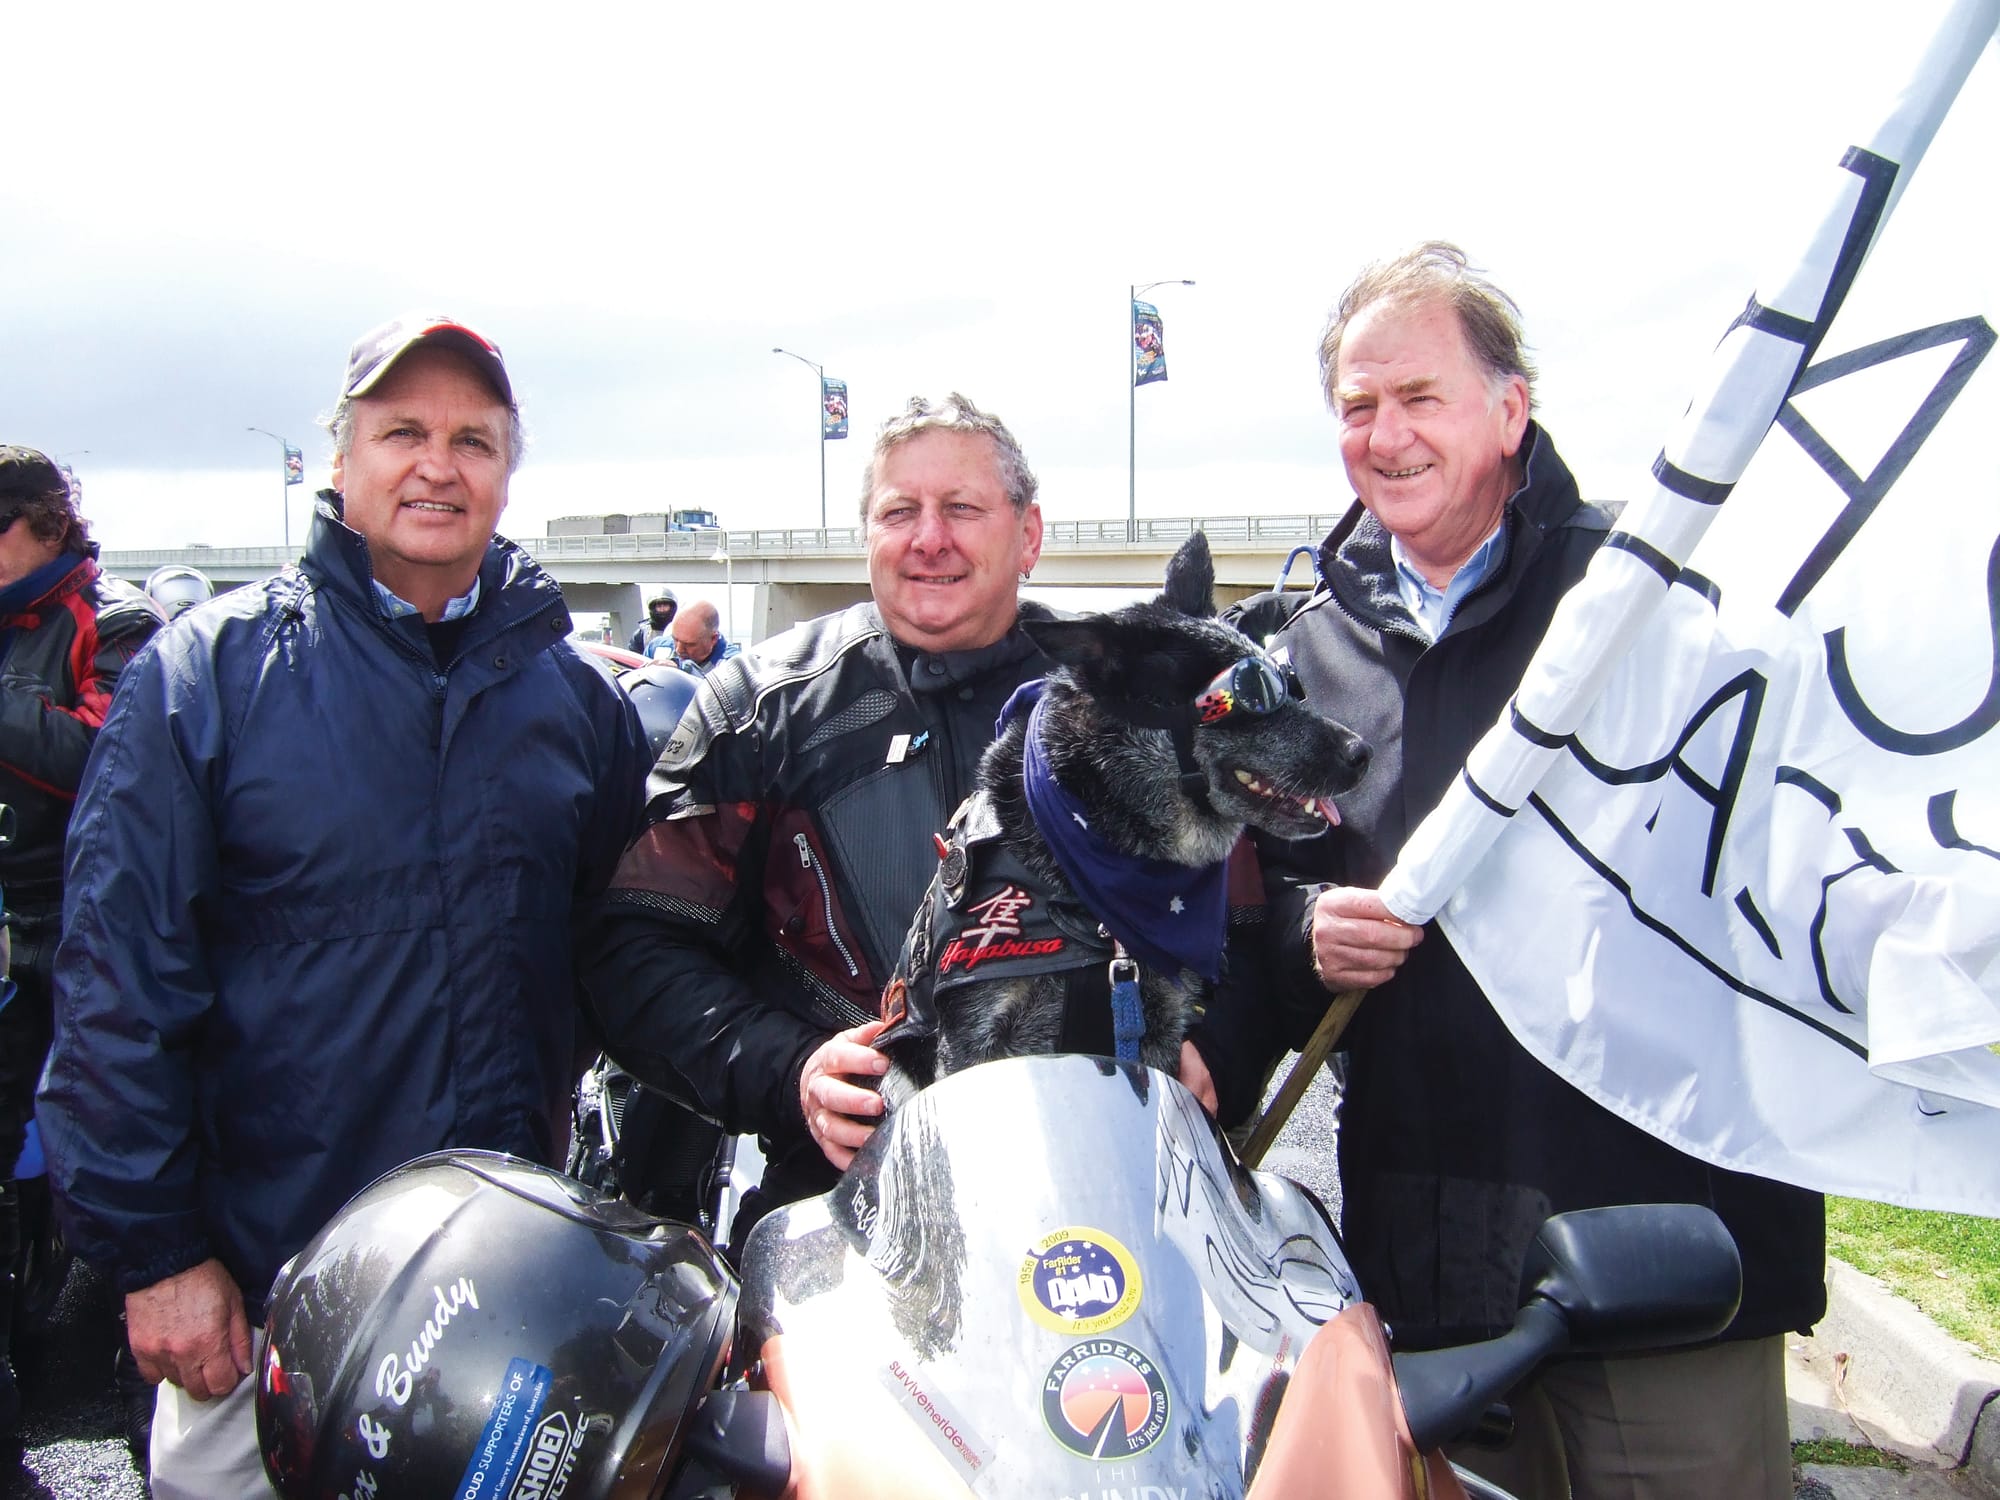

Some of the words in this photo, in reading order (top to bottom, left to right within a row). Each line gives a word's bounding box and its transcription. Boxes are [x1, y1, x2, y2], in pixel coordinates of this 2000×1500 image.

[940, 938, 1063, 973] Hayabusa
[1042, 1231, 1069, 1247] 2009
[1043, 1255, 1082, 1269] FarRider
[359, 1413, 391, 1459] &
[375, 1276, 480, 1406] Bundy
[889, 1360, 963, 1448] survivetheride
[479, 1393, 517, 1470] SUPPORTERS
[510, 1371, 524, 1392] OF
[506, 1424, 528, 1465] Foundation
[527, 1382, 544, 1416] Australia
[515, 1425, 565, 1500] SHOEI
